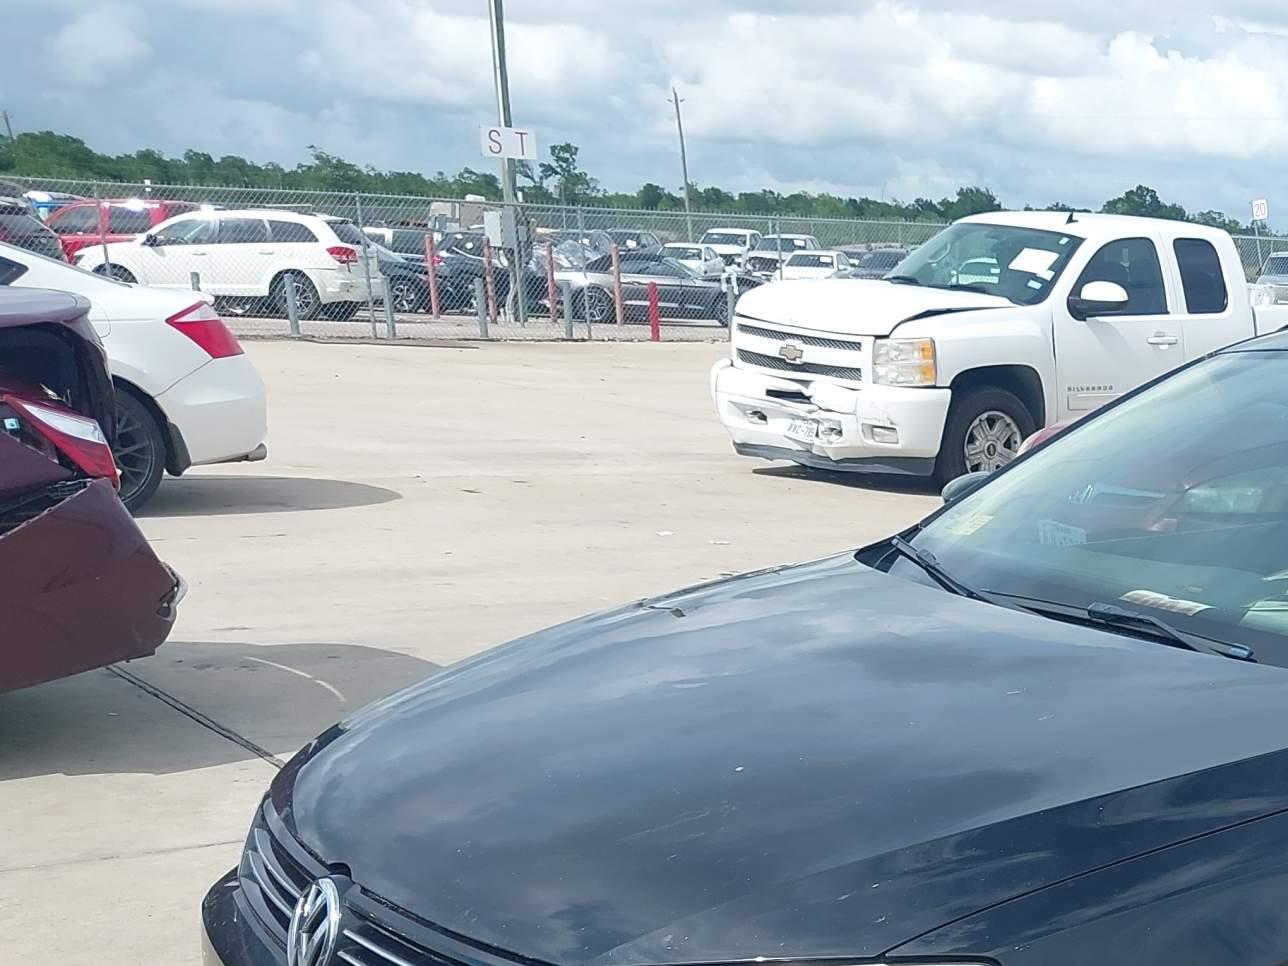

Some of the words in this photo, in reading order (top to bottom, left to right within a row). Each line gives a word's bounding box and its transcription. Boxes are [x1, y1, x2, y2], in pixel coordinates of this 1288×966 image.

[488, 129, 503, 155] S
[514, 131, 529, 156] T
[1253, 202, 1266, 217] 20
